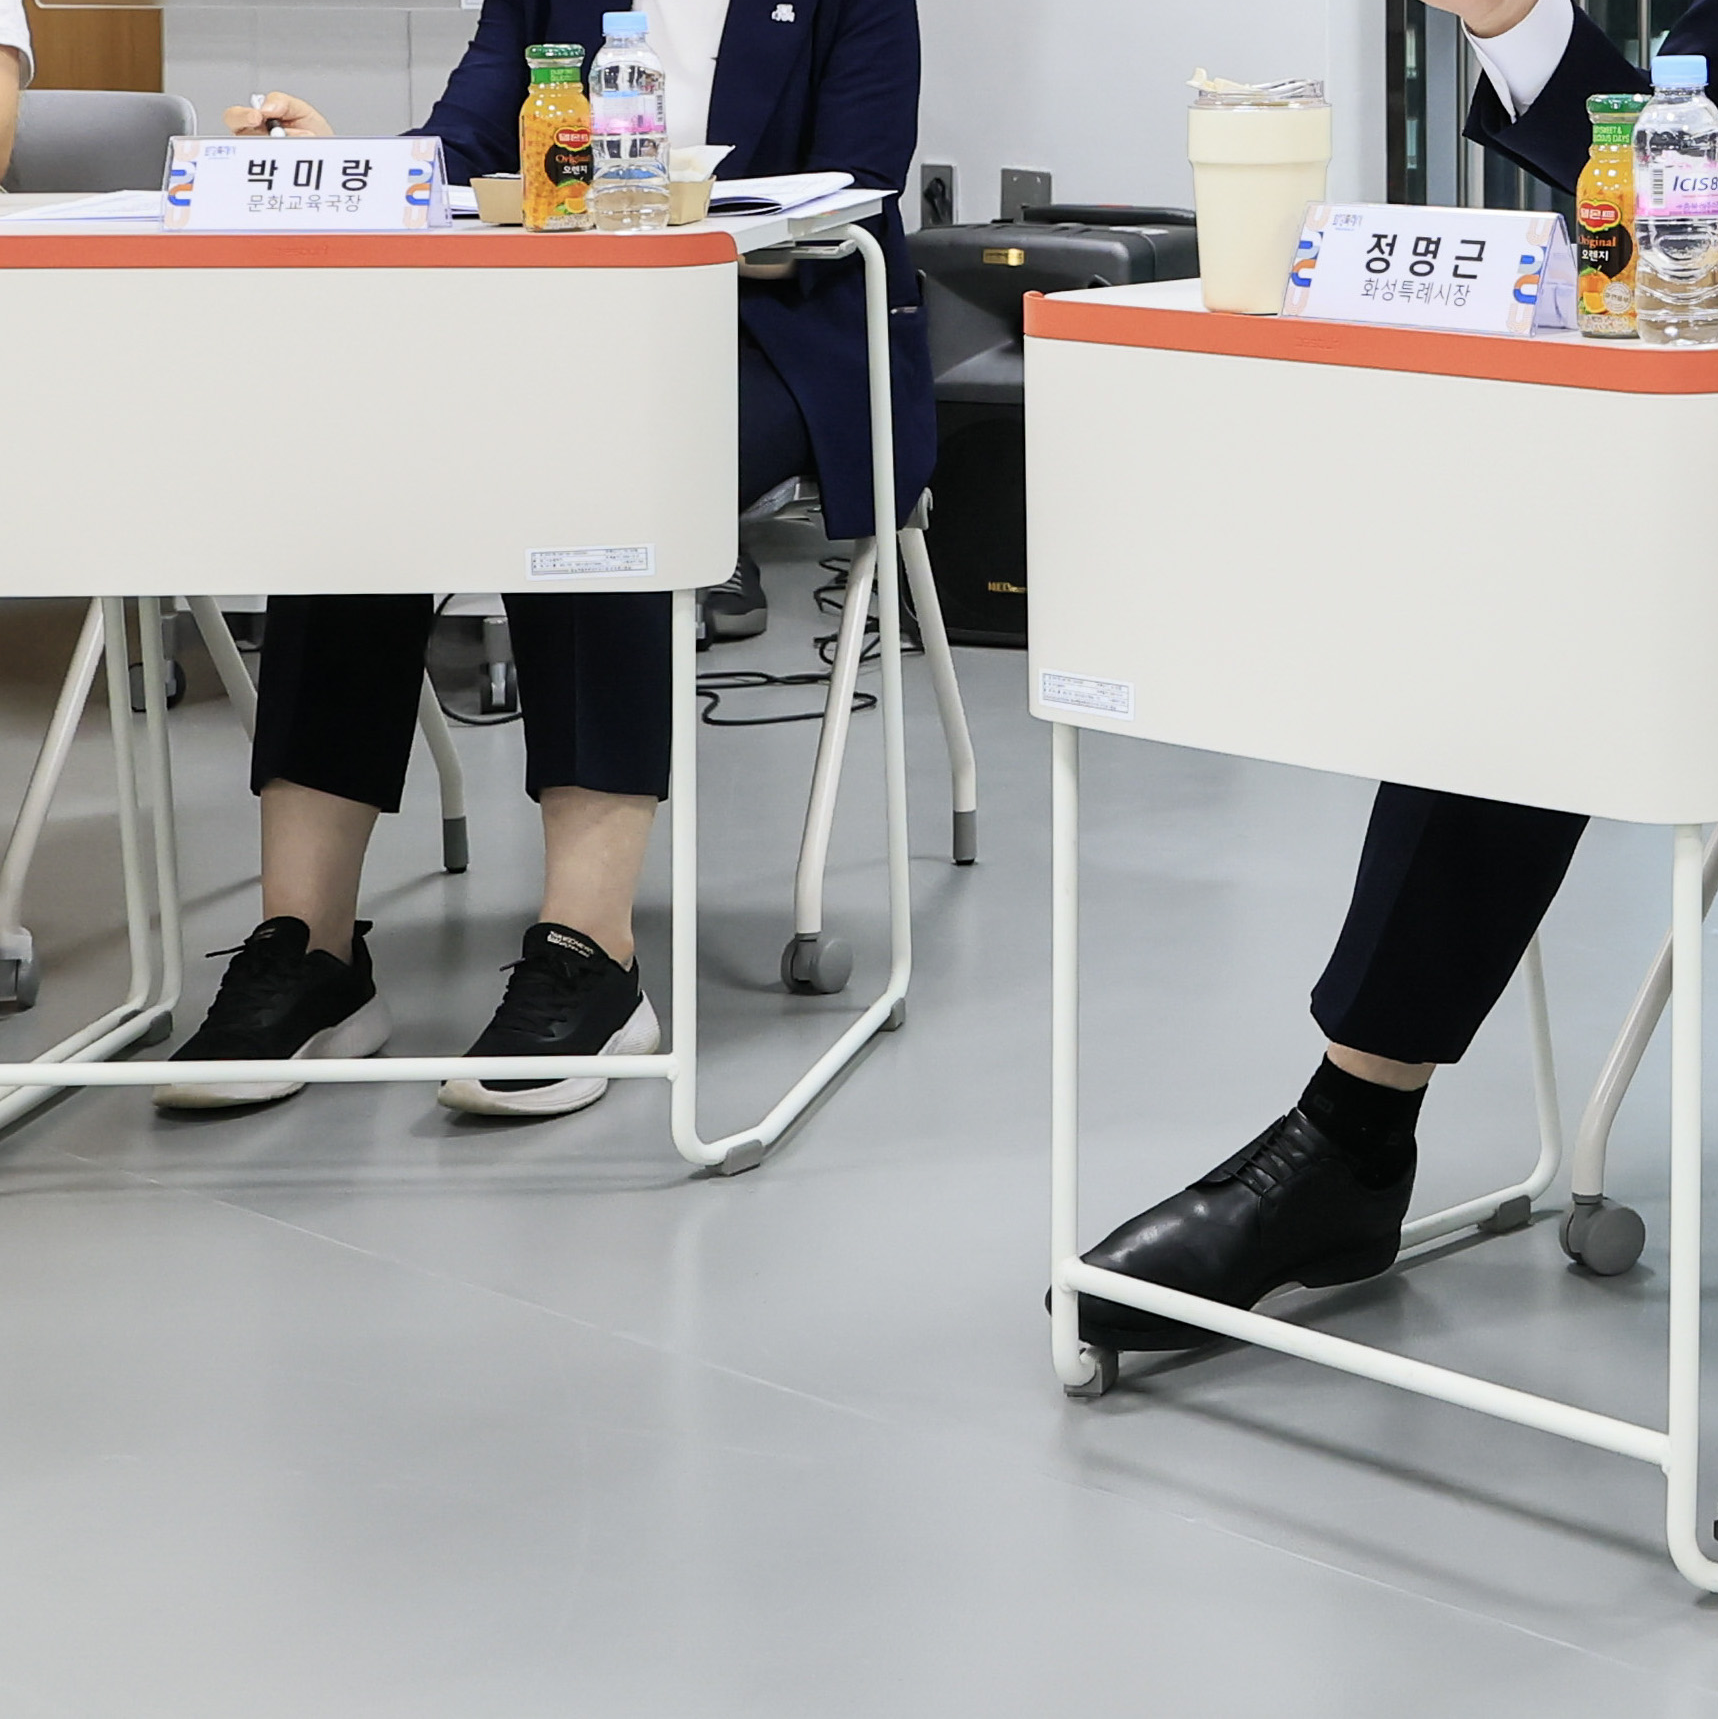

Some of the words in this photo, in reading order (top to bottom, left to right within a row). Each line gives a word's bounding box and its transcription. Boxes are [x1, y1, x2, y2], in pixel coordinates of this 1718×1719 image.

[247, 194, 363, 213] 문화교육국장
[1581, 249, 1609, 262] 오렌지
[1361, 278, 1471, 307] 화성특례시장
